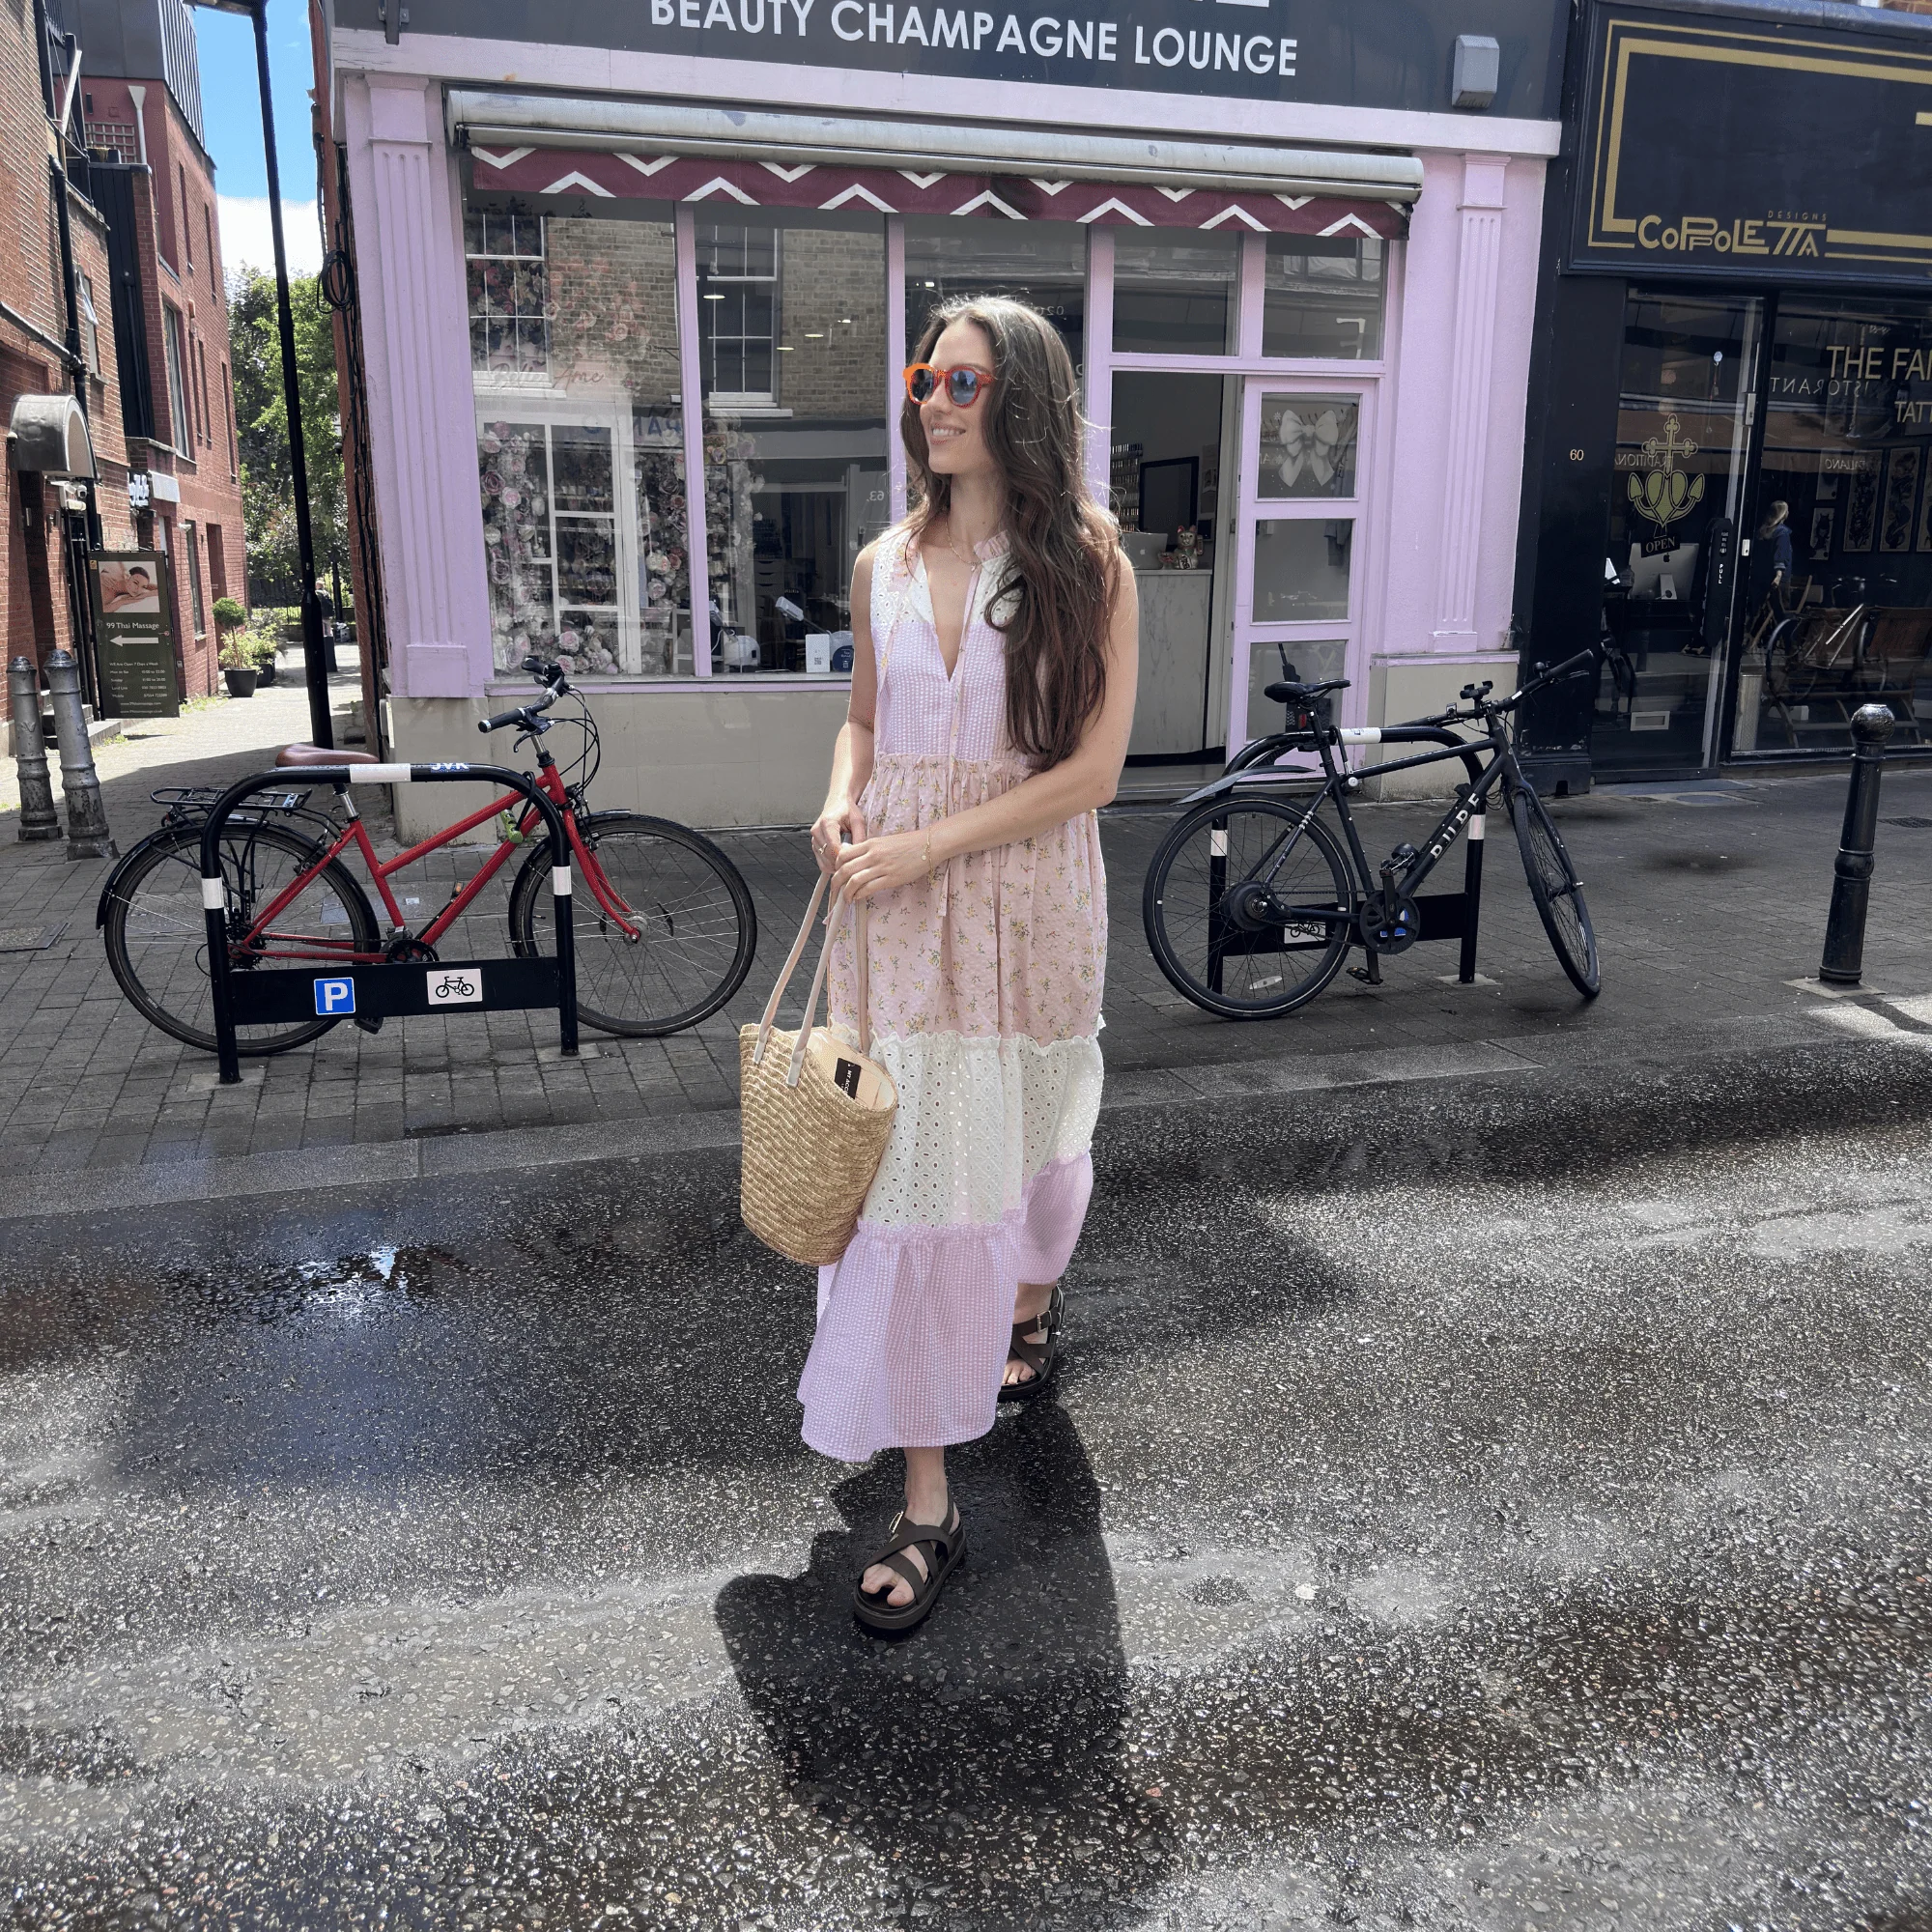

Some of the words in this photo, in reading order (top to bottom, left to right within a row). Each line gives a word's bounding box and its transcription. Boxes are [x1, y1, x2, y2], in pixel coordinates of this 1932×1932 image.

[651, 0, 814, 37] BEAUTY
[831, 0, 1118, 62] CHAMPAGNE
[1135, 25, 1297, 76] LOUNGE
[1767, 210, 1827, 221] DESIGNS
[1826, 345, 1885, 380] THE
[1570, 448, 1584, 461] 60
[1645, 536, 1676, 554] OPEN
[131, 622, 160, 631] Massage
[324, 981, 349, 1011] P
